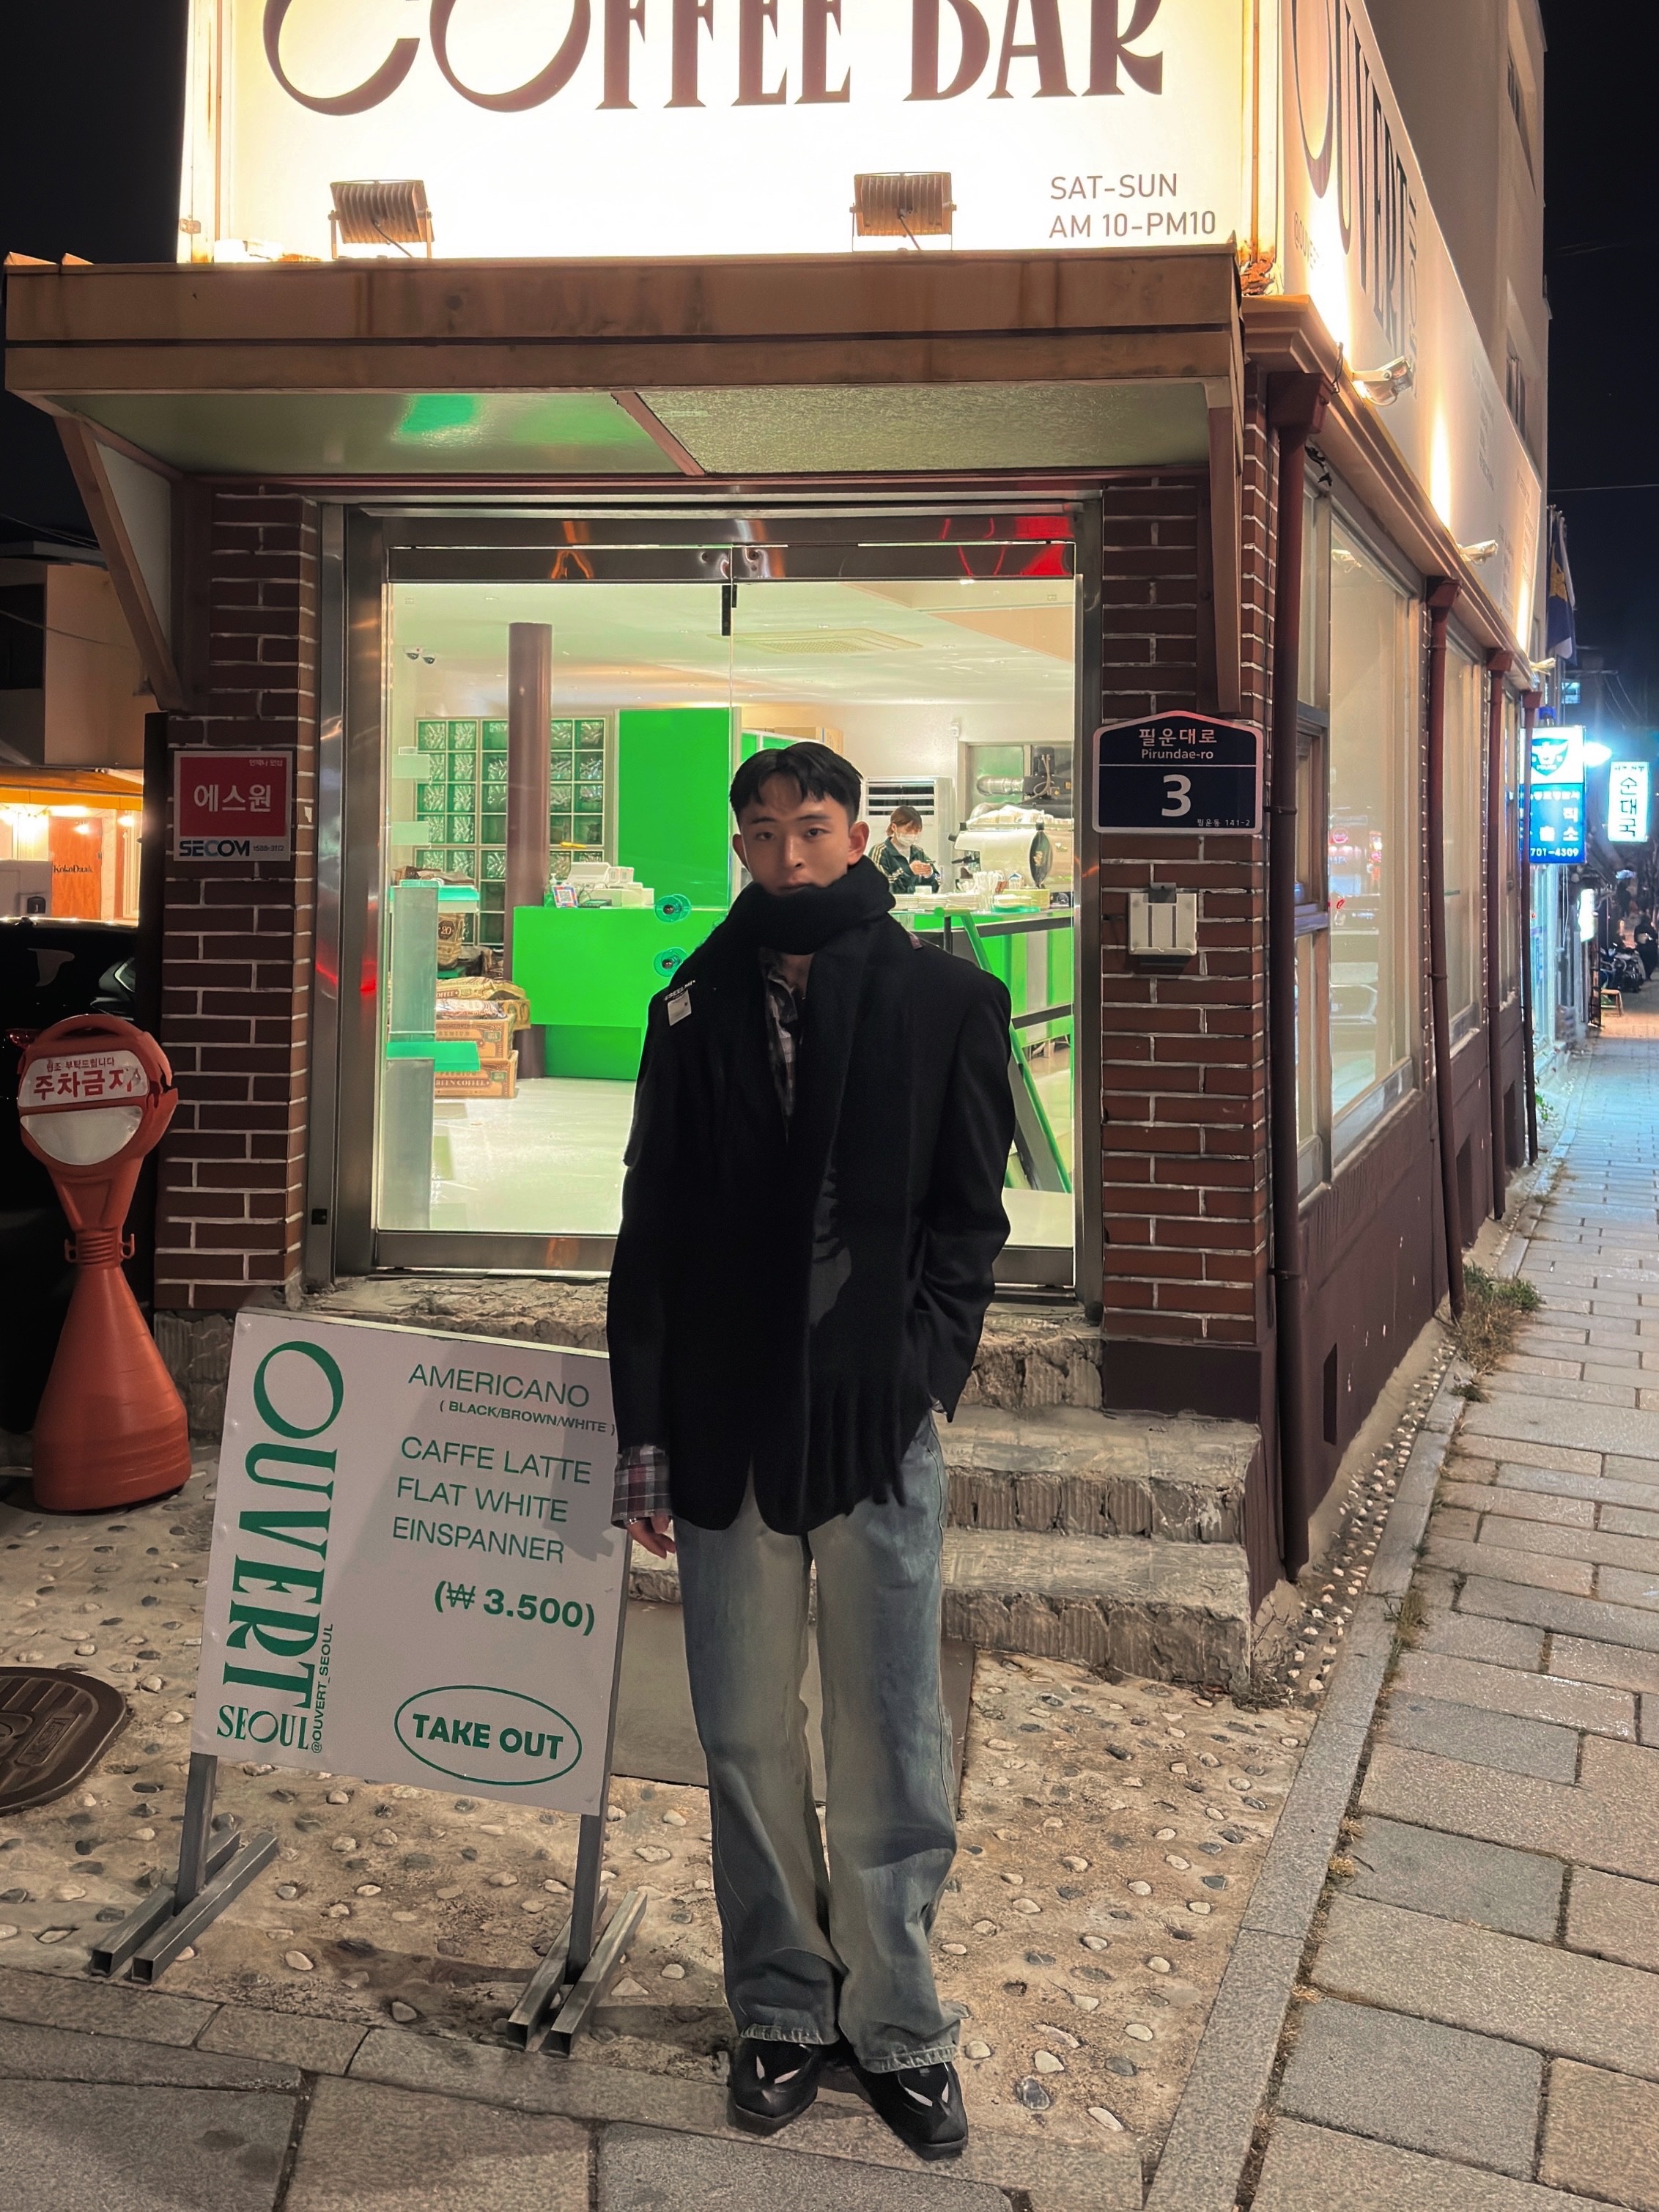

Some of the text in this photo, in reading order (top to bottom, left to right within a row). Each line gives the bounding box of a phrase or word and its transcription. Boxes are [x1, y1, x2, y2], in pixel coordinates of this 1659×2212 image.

[1050, 173, 1178, 200] SAT-SUN
[1049, 211, 1216, 238] AM 10-PM10
[1139, 728, 1217, 747] 필운대로
[1141, 748, 1214, 760] Pirundae-ro
[193, 784, 271, 812] 에스원
[1161, 774, 1191, 817] 3
[1225, 819, 1251, 827] 141-2
[180, 840, 250, 857] SECOM
[440, 926, 452, 935] 20
[66, 1057, 114, 1069] 부탁드립니다
[34, 1069, 133, 1101] 주차금지
[407, 1363, 590, 1407] AMERICANO
[401, 1435, 592, 1485] CAFFE LATTE
[397, 1476, 569, 1524] FLAT WHITE
[222, 1341, 344, 1709] OUVERT
[392, 1516, 564, 1564] EINSPANNER
[310, 1622, 335, 1755] @OUVERT_SEOUL
[216, 1704, 309, 1752] SEOUL
[412, 1712, 564, 1761] TAKE OUT
